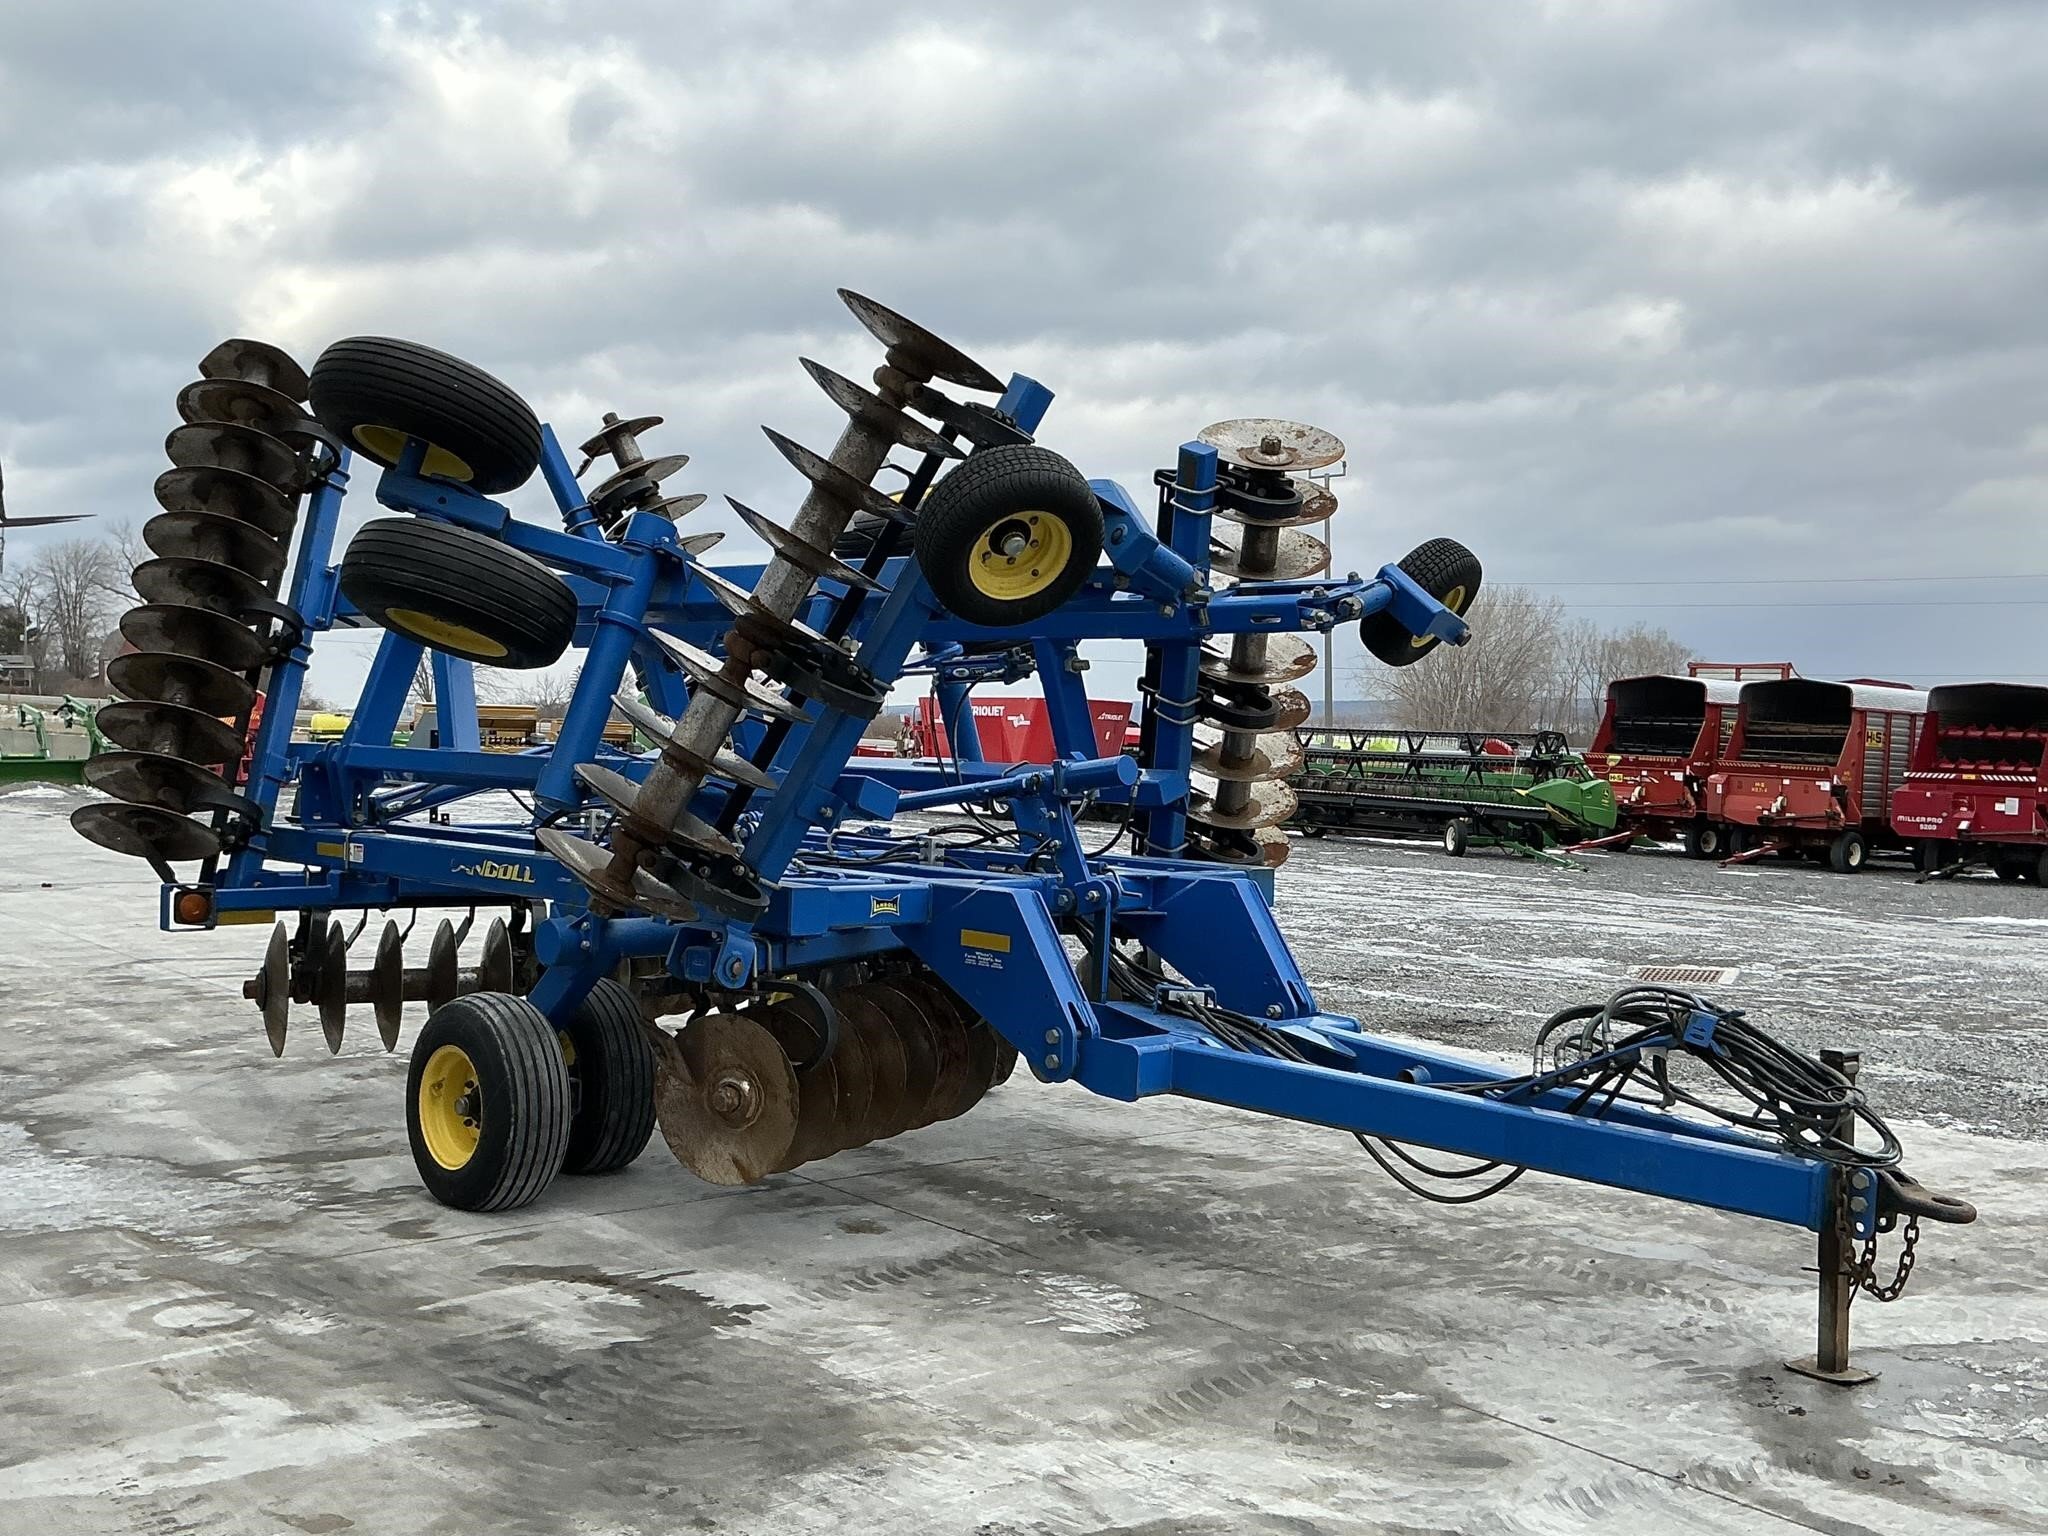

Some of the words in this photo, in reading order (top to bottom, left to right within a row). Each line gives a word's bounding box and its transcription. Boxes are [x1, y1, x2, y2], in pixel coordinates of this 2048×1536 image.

[1897, 815, 1926, 823] MILLER
[1926, 816, 1943, 824] PRO
[451, 858, 535, 882] NDOLL
